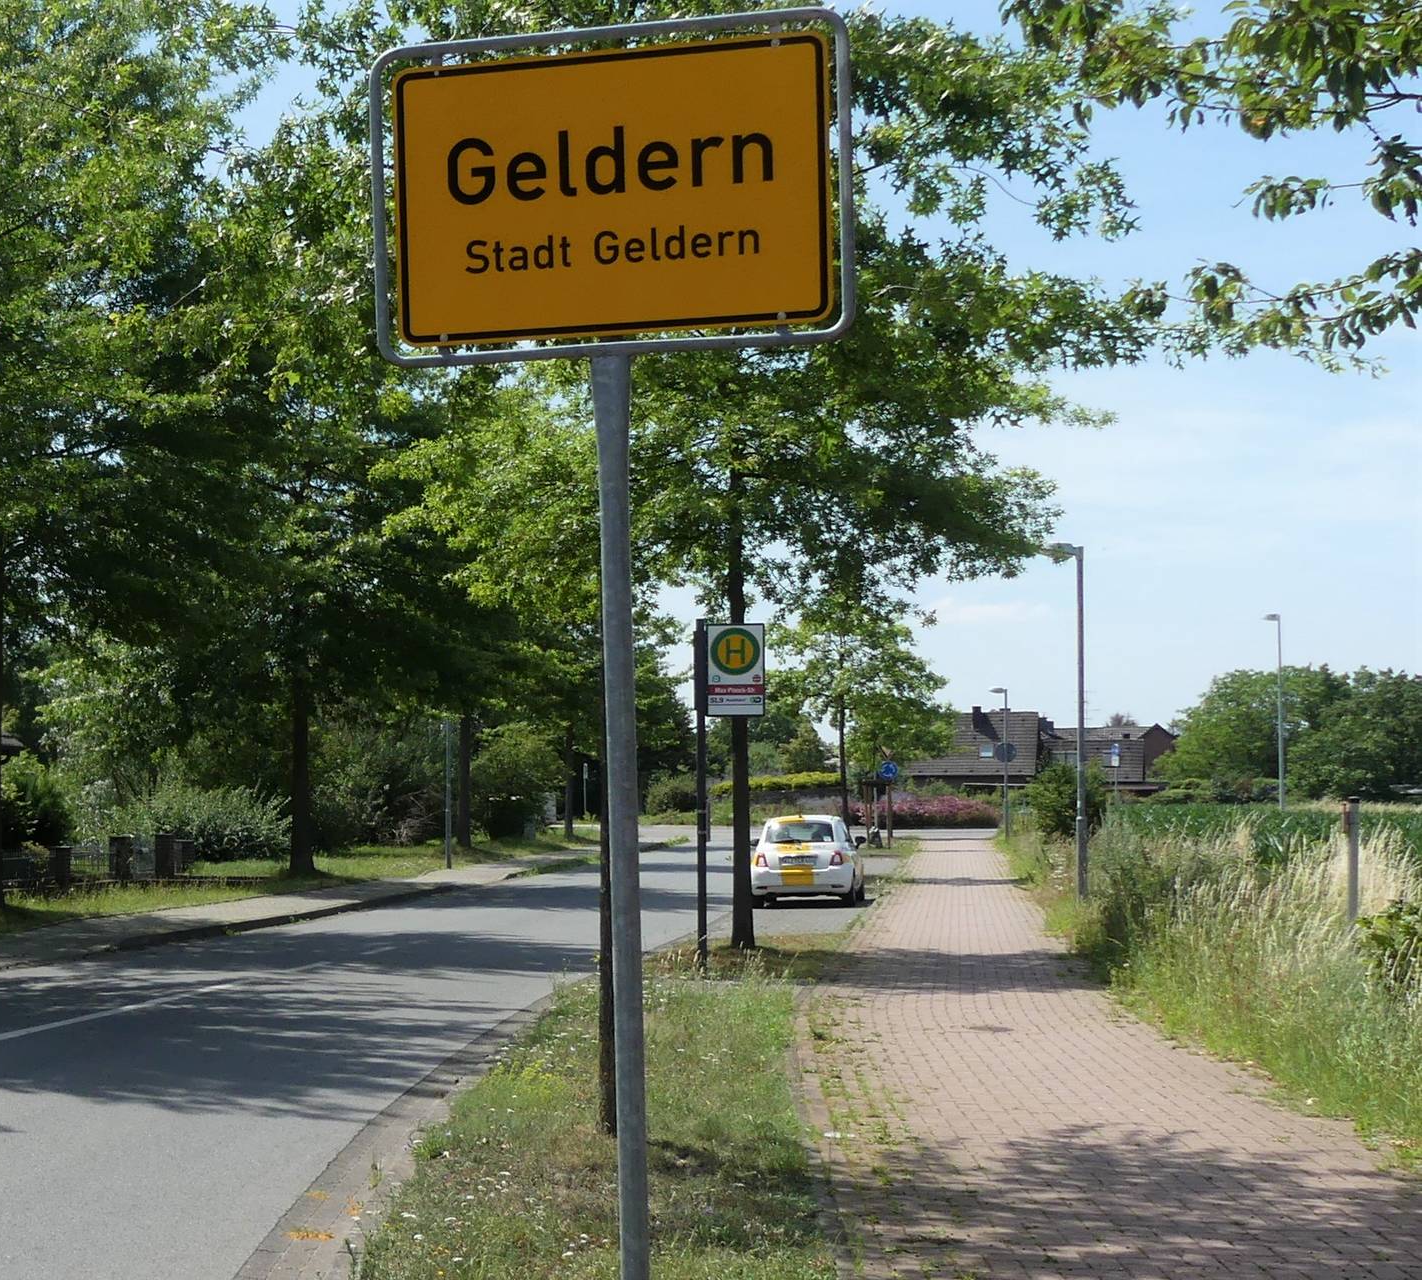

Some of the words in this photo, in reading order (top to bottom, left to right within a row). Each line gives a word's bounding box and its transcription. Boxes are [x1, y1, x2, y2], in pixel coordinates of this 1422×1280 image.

[447, 126, 774, 205] Geldern
[465, 235, 572, 275] Stadt
[593, 225, 760, 265] Geldern
[725, 638, 746, 665] H
